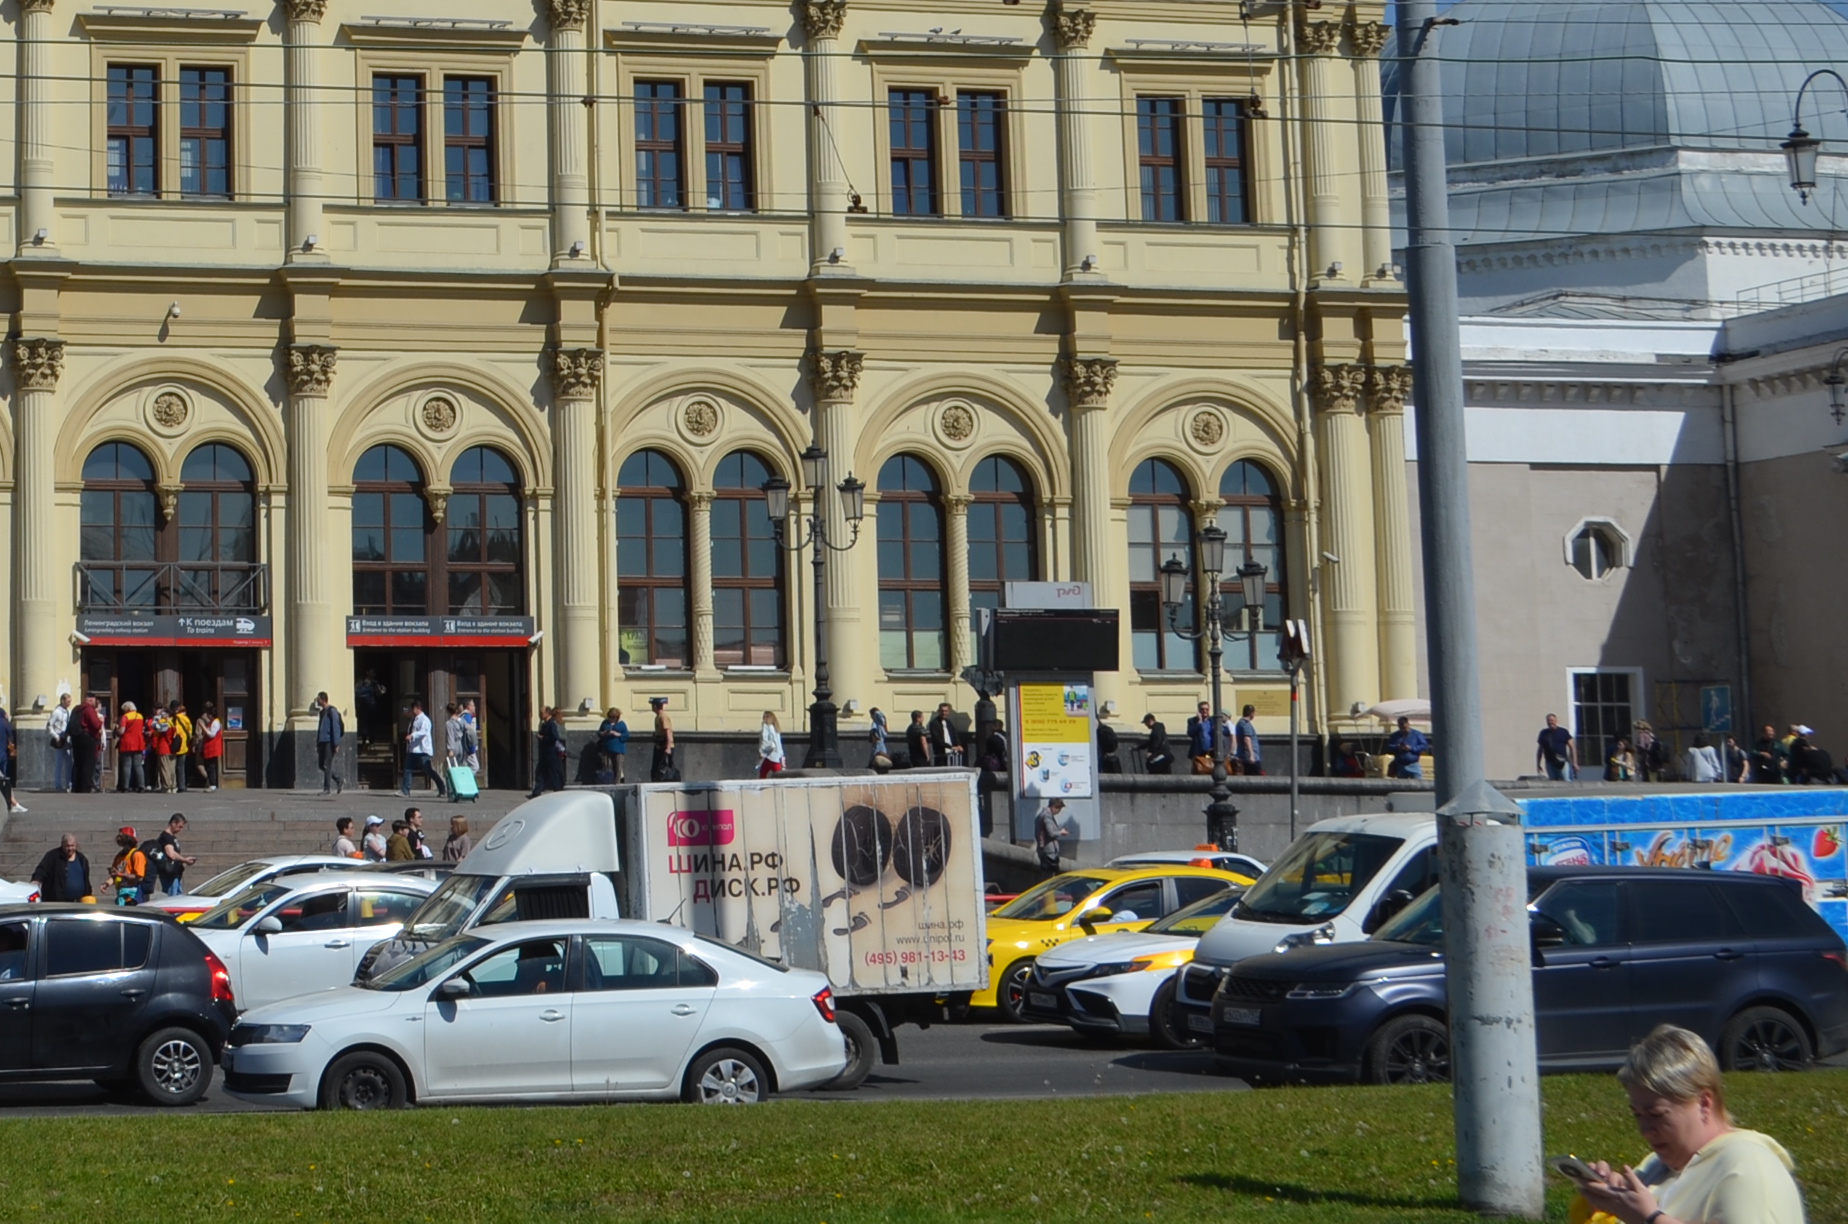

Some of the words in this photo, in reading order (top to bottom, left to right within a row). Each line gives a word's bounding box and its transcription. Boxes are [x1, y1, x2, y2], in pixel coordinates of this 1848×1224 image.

[84, 619, 131, 627] Ленинградский
[186, 618, 193, 626] К
[195, 618, 234, 627] поездам
[362, 619, 376, 627] Вход
[456, 620, 471, 628] Вход
[669, 852, 783, 874] ШИНА.РФ
[693, 877, 801, 904] ДИСК.РФ
[896, 933, 965, 945] www.unipol.ru
[865, 950, 897, 966] (495)
